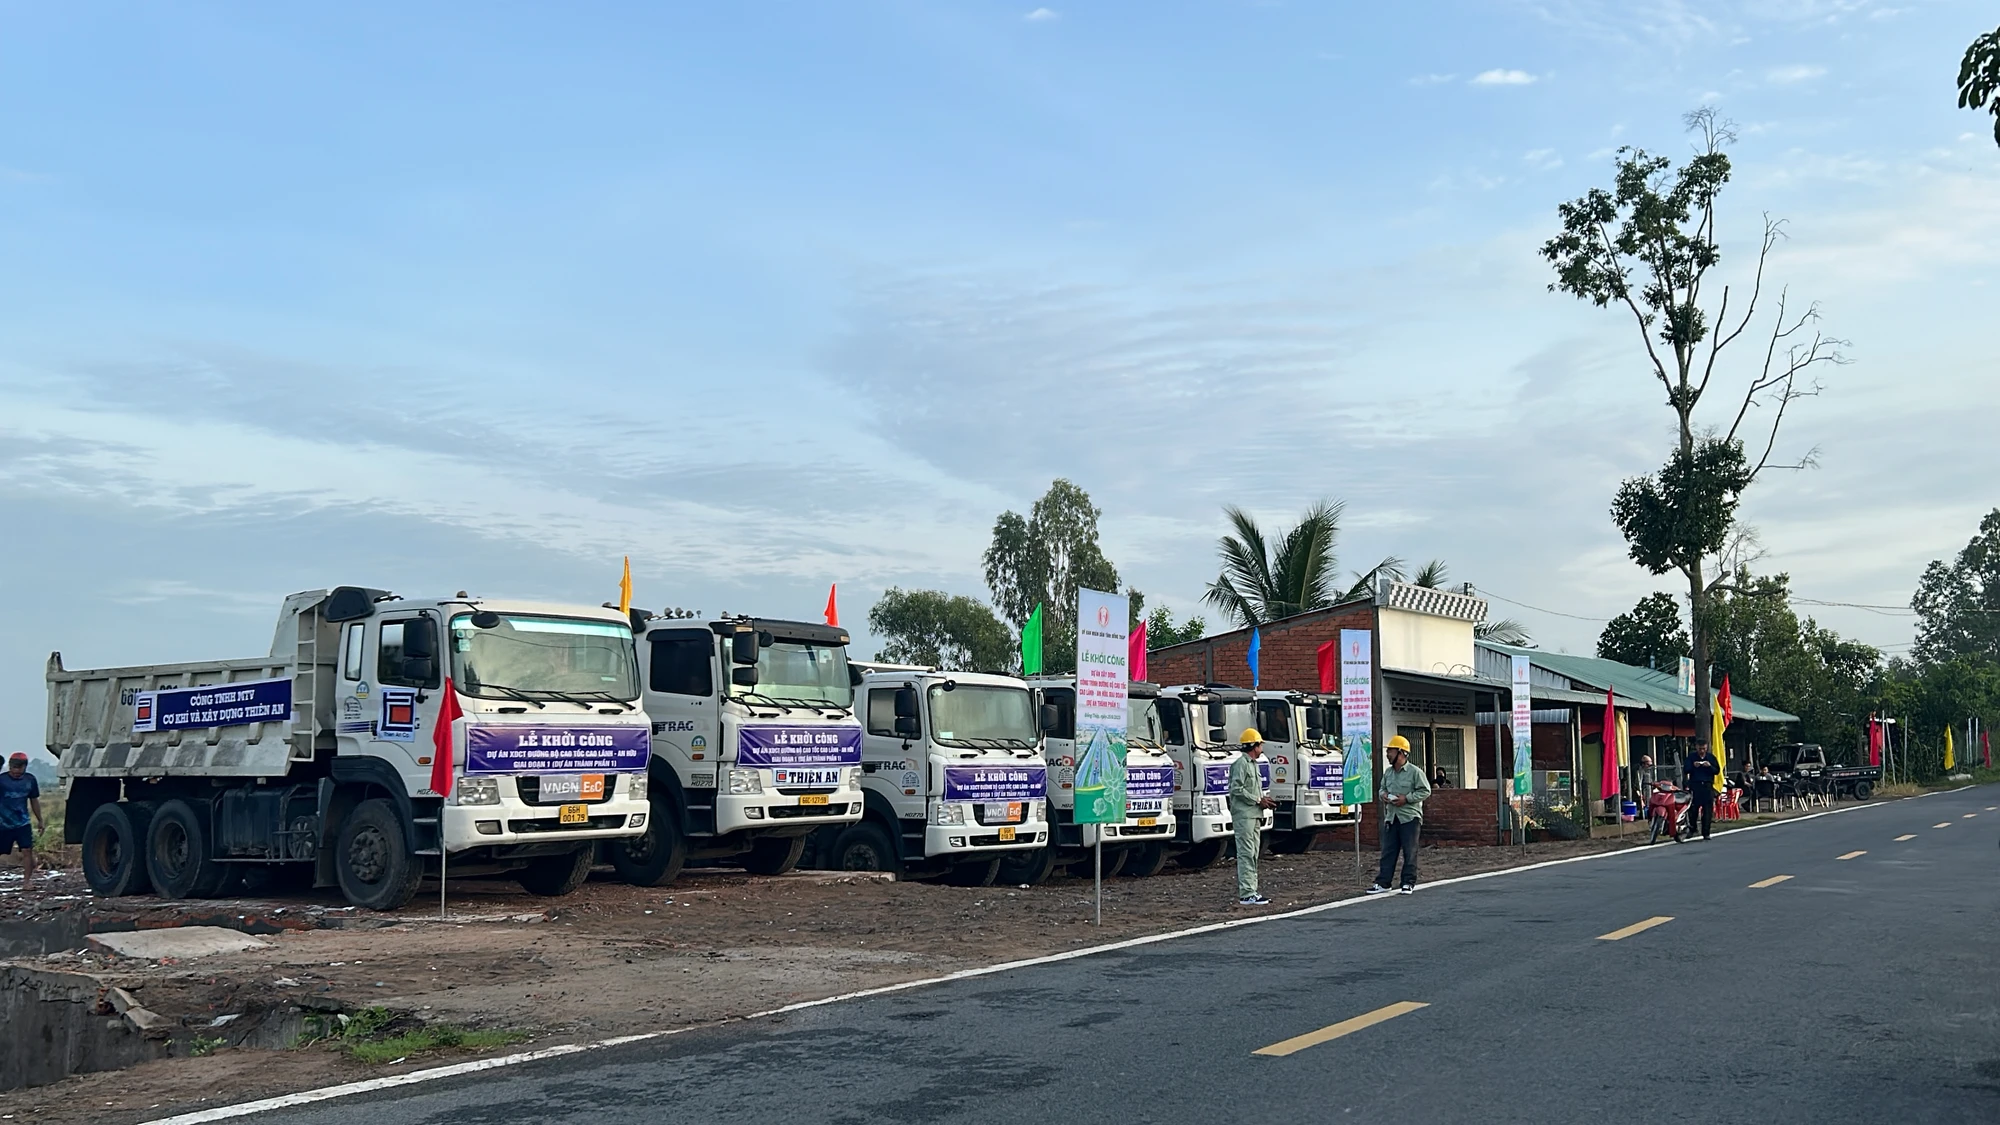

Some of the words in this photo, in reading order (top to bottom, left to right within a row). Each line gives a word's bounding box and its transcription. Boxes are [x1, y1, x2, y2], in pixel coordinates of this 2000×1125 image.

[1107, 654, 1125, 666] CÔNG
[190, 693, 213, 706] CÔNG
[214, 692, 236, 704] TNHH
[237, 689, 255, 701] MTV
[163, 713, 174, 725] CƠ
[175, 710, 189, 724] KHÍ
[190, 709, 200, 722] VÀ
[202, 709, 218, 722] XÂY
[219, 708, 243, 721] DỰNG
[245, 703, 270, 717] THIÊN
[271, 704, 284, 715] AN
[519, 730, 538, 746] LỄ
[542, 731, 575, 746] KHỞI
[579, 732, 613, 746] CÔNG
[774, 731, 788, 744] LỄ
[790, 731, 812, 744] KHỞI
[815, 732, 838, 744] CÔNG
[487, 750, 497, 759] DỰ
[550, 750, 559, 758] BỘ
[573, 749, 584, 757] TỐC
[789, 770, 822, 783] THIÊN
[825, 772, 838, 782] AN
[975, 770, 986, 781] LỄ
[988, 770, 1007, 781] KHỞI
[1009, 771, 1027, 781] CÔNG
[1147, 771, 1161, 780] CÔNG
[584, 781, 602, 792] E&C
[1154, 801, 1162, 810] AN
